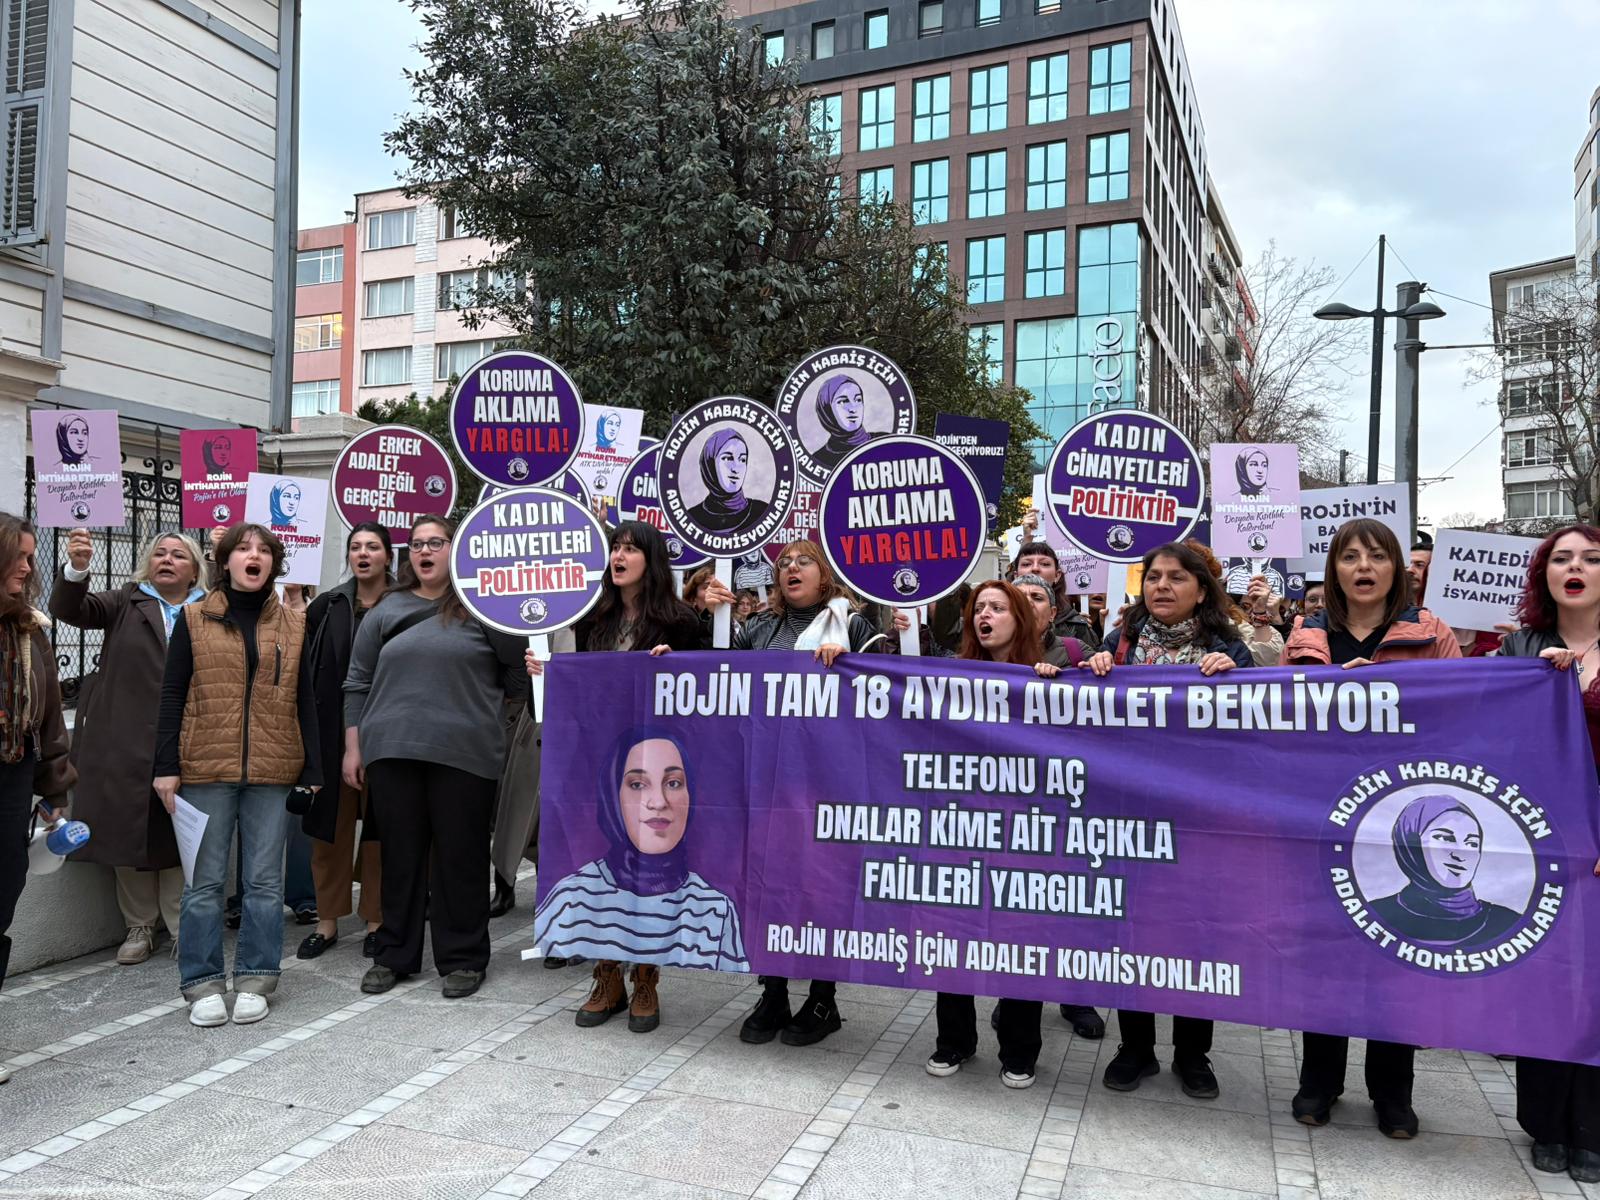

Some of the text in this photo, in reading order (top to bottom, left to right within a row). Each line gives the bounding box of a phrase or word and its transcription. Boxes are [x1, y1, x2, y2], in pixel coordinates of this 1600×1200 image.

[479, 369, 553, 392] KORUMA
[780, 350, 897, 414] ROJİN KABAİŞ İÇİN
[474, 396, 561, 423] AKLAMA
[379, 435, 422, 456] ERKEK
[466, 427, 570, 453] YARGILA!
[665, 404, 786, 461] ROJİN KABAİŞ İÇİN
[1094, 422, 1167, 453] KADIN
[62, 461, 91, 472] ROJİN
[348, 455, 400, 472] ADALET
[578, 451, 605, 460] NTİHAR
[949, 445, 1004, 457] GEÇMİYORUZ!
[38, 472, 77, 482] İNTİHAR
[206, 472, 233, 481] ROJİN
[379, 472, 417, 493] DEĞİL
[851, 456, 944, 491] KORUMA
[1066, 447, 1190, 487] CİNAYETLERİ
[184, 481, 220, 491] İNTİHAR
[343, 487, 396, 512] GERÇEK
[1241, 492, 1270, 503] ROJİN
[493, 501, 565, 527] KADIN
[666, 489, 706, 540] ADALET
[703, 480, 791, 551] KOMİSYONLARI
[848, 489, 955, 529] AKLAMA
[1071, 486, 1177, 523] POLİTİKTİR
[1215, 502, 1256, 513] İNTİHAR
[1301, 496, 1397, 520] ROJİN'İN
[469, 525, 592, 559] CİNAYETLERİ
[839, 527, 969, 565] YARGILA!
[479, 562, 585, 594] POLİTİKTİR
[654, 663, 1416, 734] ROJİN TAM 18 AYDIR ADALET BEKLİYOR.
[903, 753, 1085, 808] TELEFONU AÇ
[1328, 761, 1553, 840] ROJİN KABAİŞ İÇİN
[816, 802, 1175, 868] DNALAR KİME AİT AÇIKLA
[864, 855, 1124, 917] FAİLLERİ YARGILA!
[1330, 867, 1564, 973] ADALET KOMİSYONLARI
[766, 921, 1241, 996] ROJİN KABAİŞ İÇİN ADALET KOMİSYONLARI
